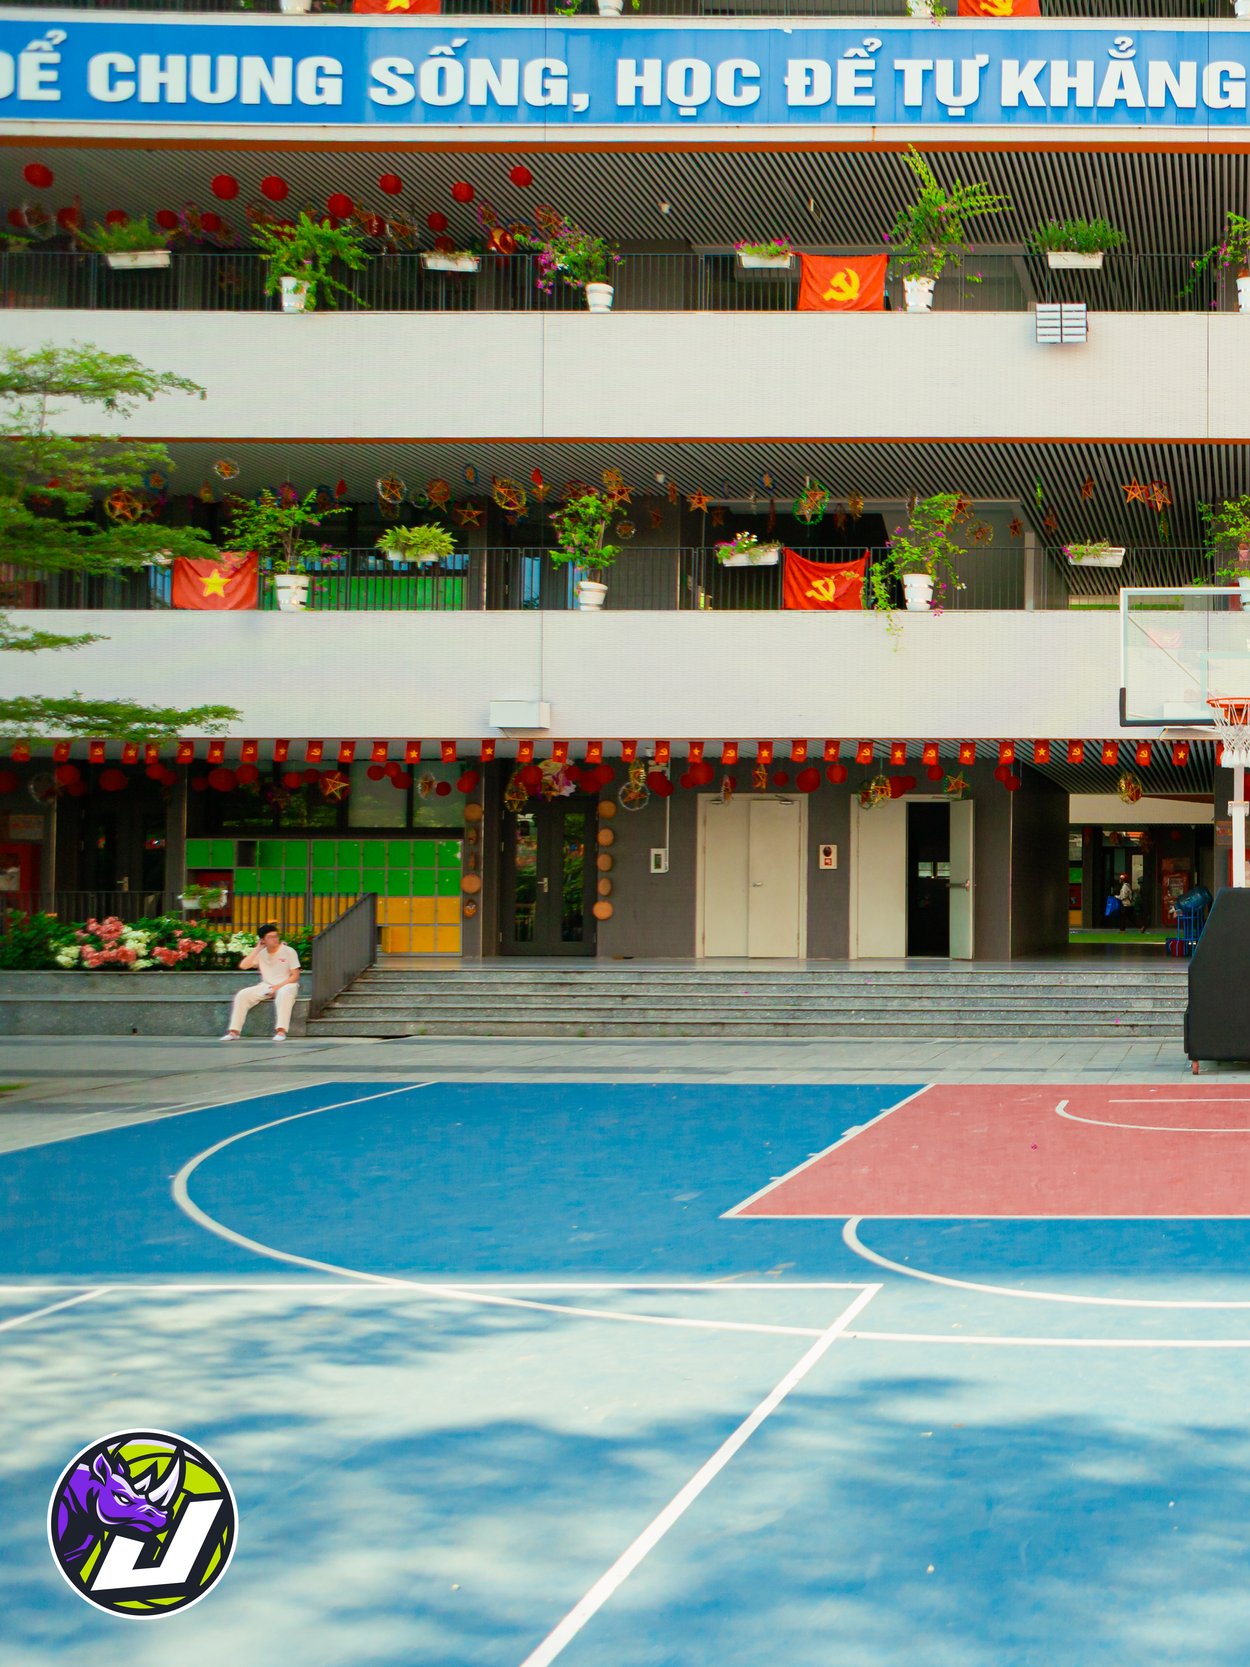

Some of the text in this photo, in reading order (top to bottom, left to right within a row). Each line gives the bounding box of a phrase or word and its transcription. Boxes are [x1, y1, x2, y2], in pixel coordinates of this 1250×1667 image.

[0, 30, 67, 100] Ể
[87, 53, 343, 105] CHUNG
[368, 38, 590, 113] SỐNG,
[615, 57, 762, 117] HỌC
[783, 37, 883, 107] ĐỂ
[893, 53, 990, 117] TỰ
[1000, 35, 1247, 110] KHẲNG
